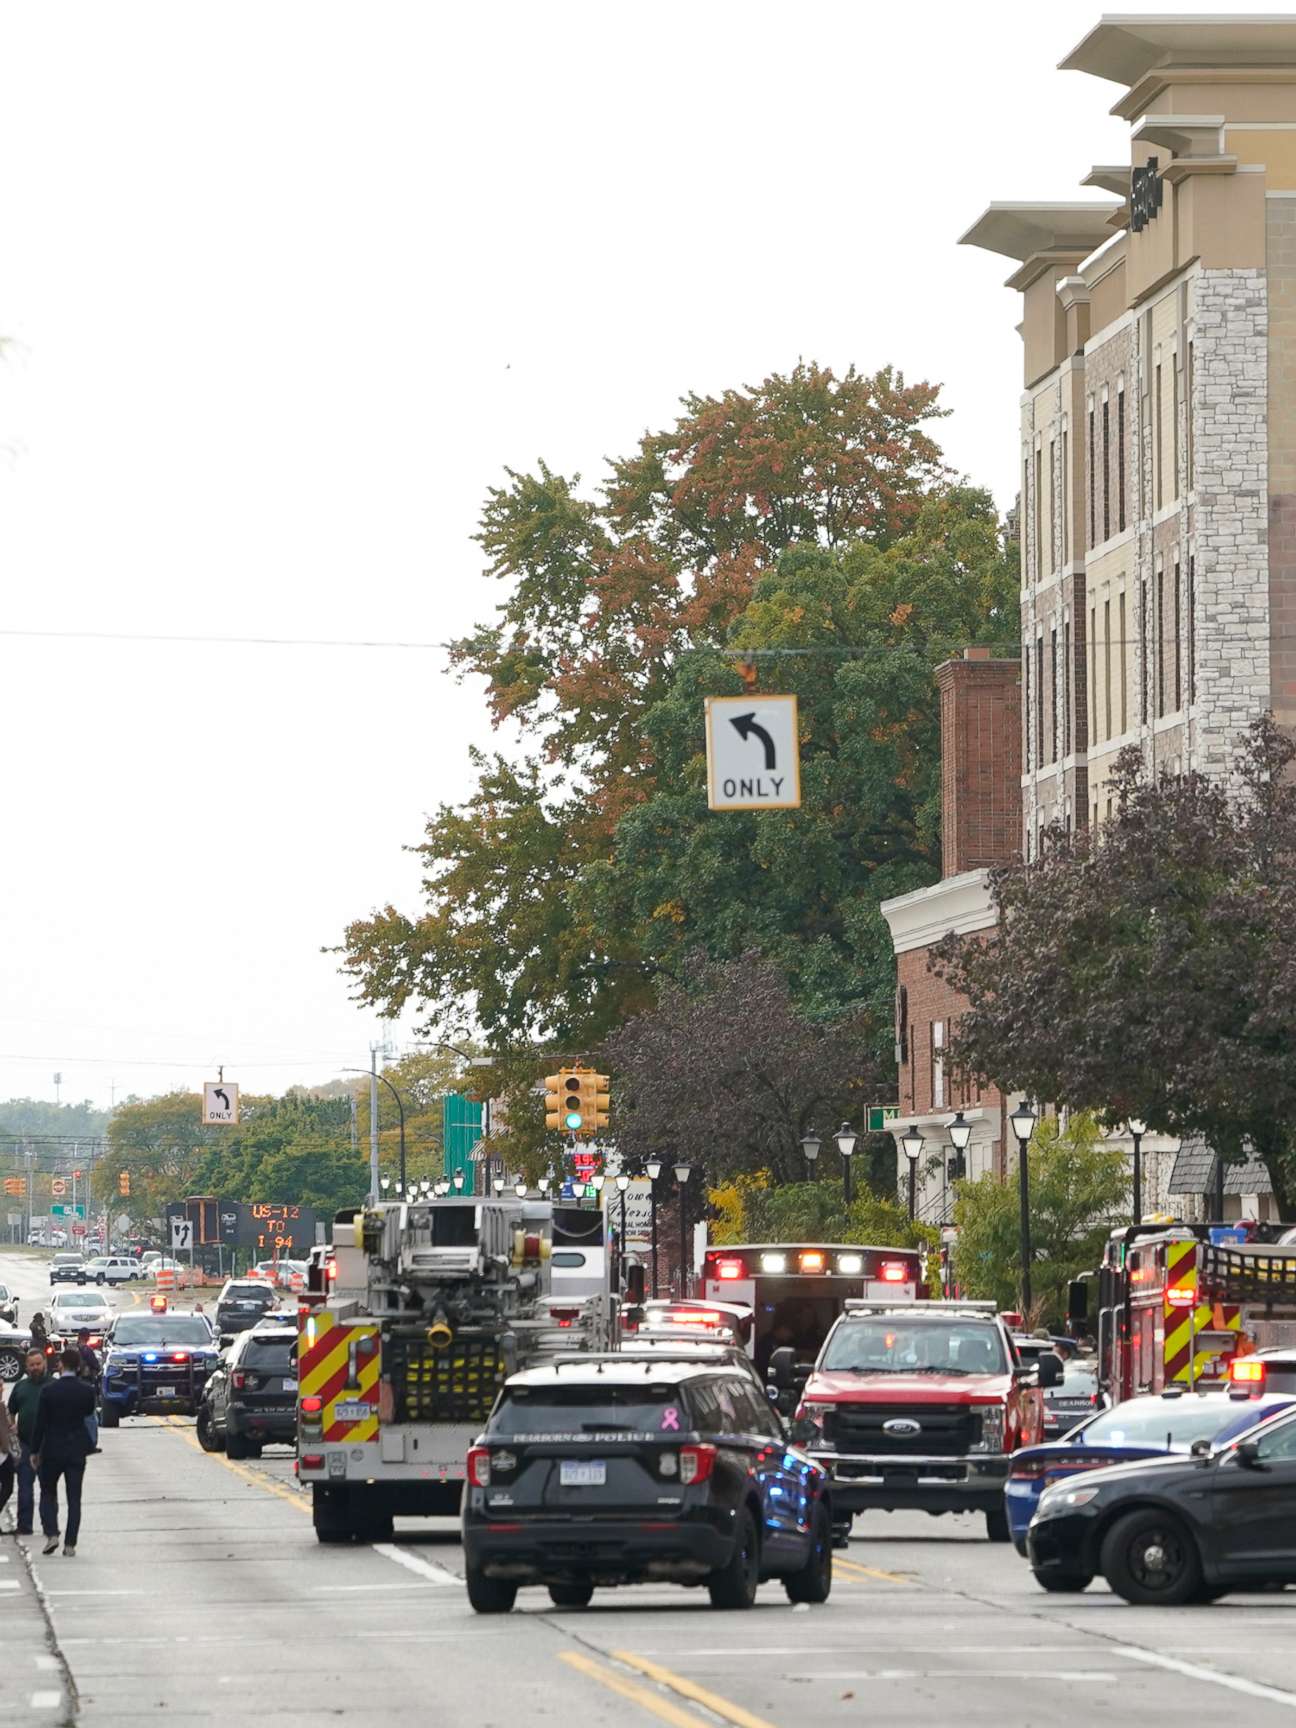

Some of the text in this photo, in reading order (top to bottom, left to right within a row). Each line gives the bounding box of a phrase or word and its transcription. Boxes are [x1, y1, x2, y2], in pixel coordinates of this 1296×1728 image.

[723, 777, 784, 798] ONLY
[209, 1111, 232, 1120] ONLY
[252, 1205, 300, 1219] US-12
[266, 1219, 286, 1233] TO
[594, 1432, 655, 1443] POLICE
